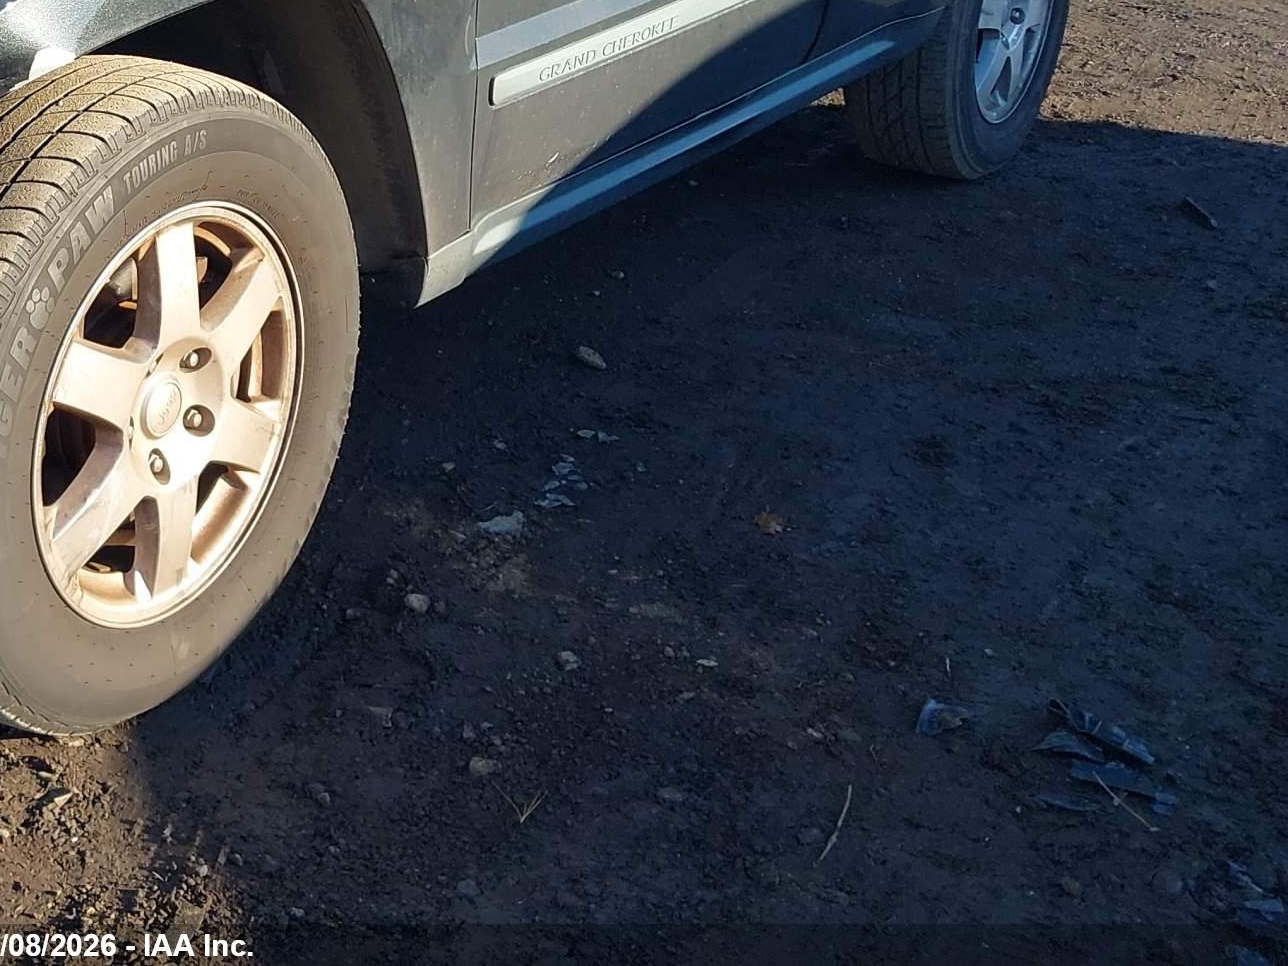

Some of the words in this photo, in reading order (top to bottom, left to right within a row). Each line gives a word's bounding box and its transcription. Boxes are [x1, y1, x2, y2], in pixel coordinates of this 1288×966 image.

[538, 49, 596, 82] GRAND
[601, 14, 681, 57] CHEROKEE
[47, 184, 115, 293] PAW
[122, 140, 179, 195] TOURING
[183, 129, 208, 155] A/S
